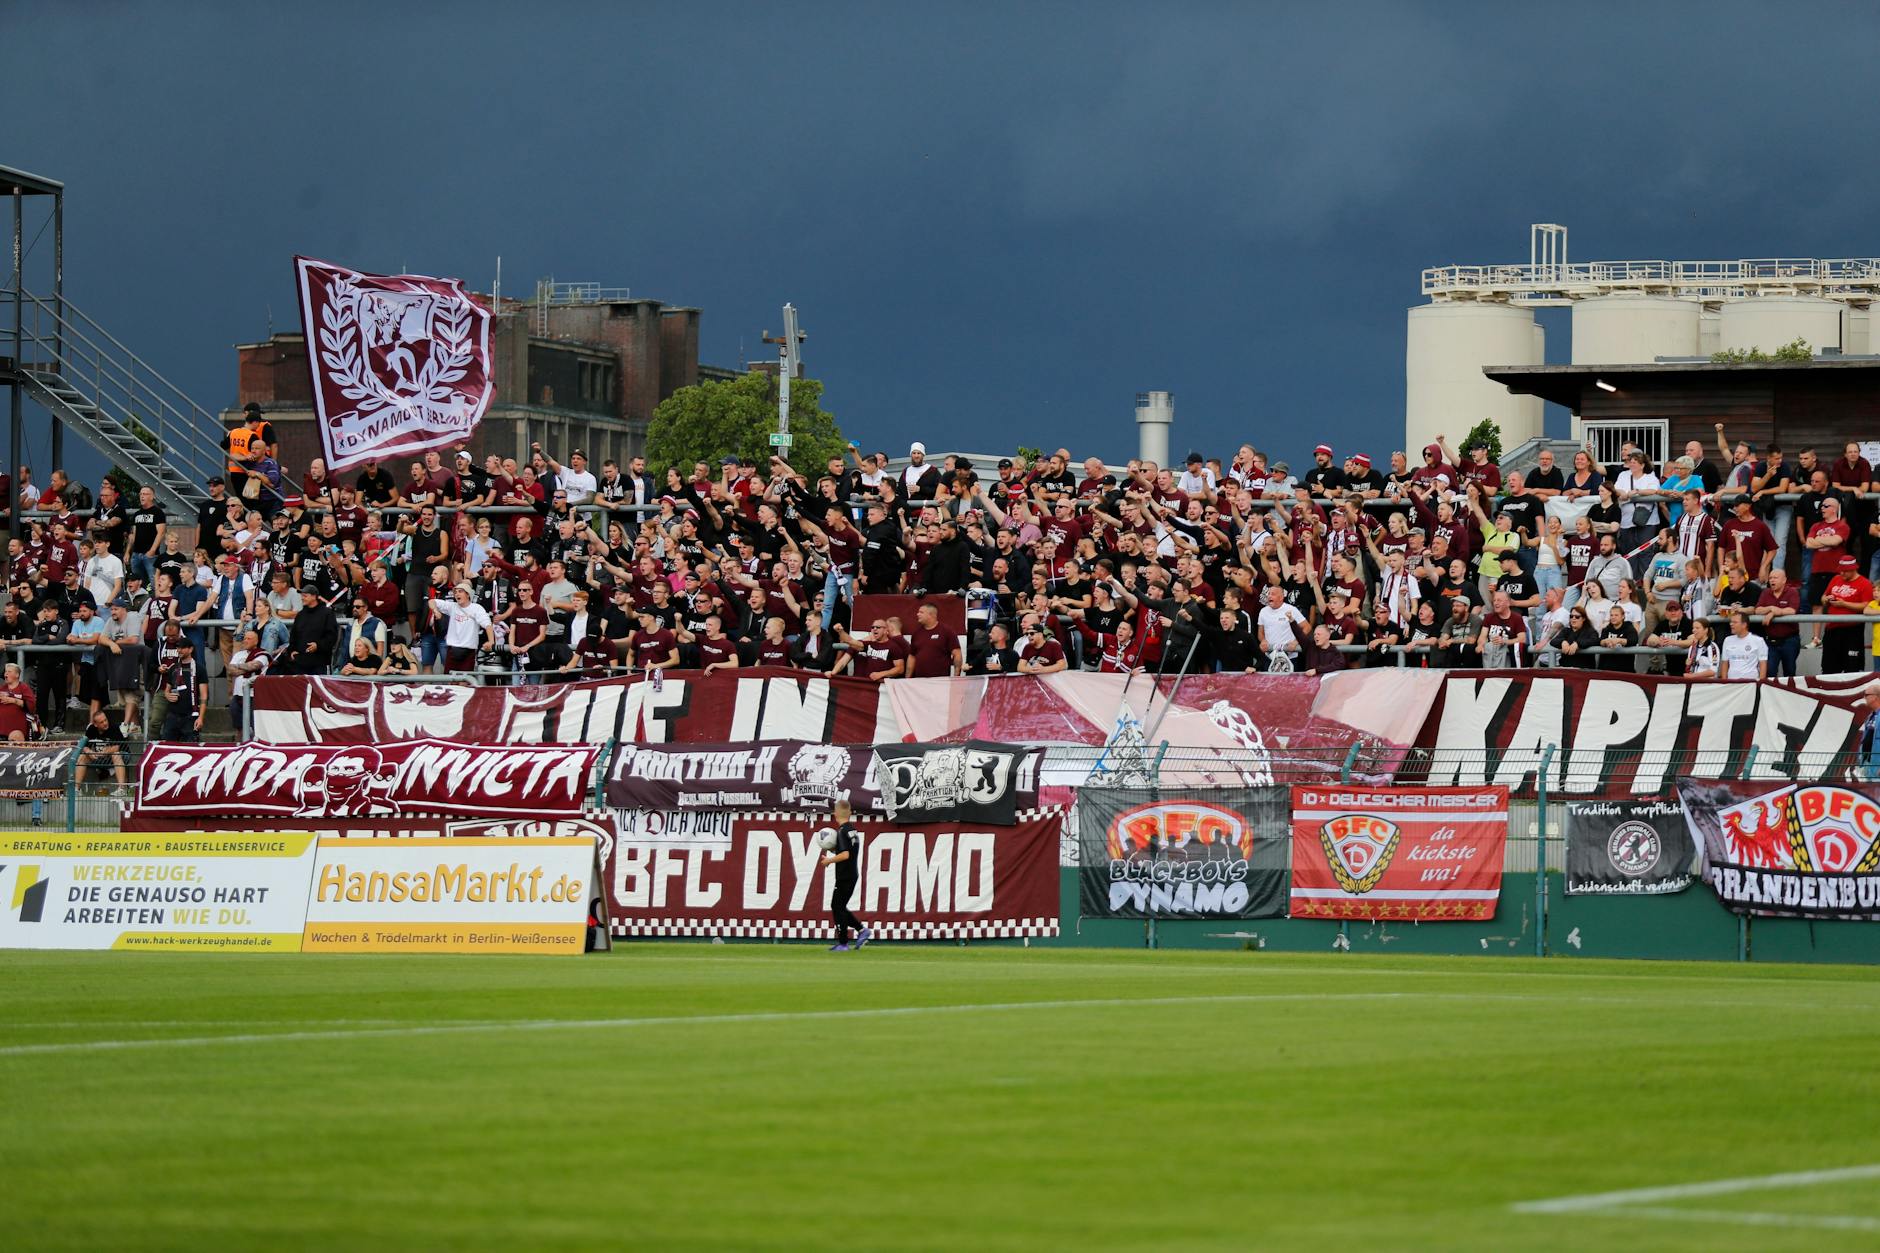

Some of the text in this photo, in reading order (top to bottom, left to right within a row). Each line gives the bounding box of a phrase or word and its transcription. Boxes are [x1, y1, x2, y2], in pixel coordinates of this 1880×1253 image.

[303, 559, 321, 571] BFC
[143, 744, 589, 801] BANDA INVICTA
[1329, 793, 1426, 807] DEUTSCHER
[1428, 794, 1498, 807] MEISTER
[1569, 802, 1621, 816] Tradition
[1800, 790, 1880, 838] BFC
[615, 808, 638, 834] ICK
[1330, 817, 1389, 841] BFC
[1430, 826, 1456, 841] da
[13, 841, 285, 851] BERATUNG REPARATUR BAUSTELLENSERVICE
[73, 865, 203, 883] WERKZEUGE,
[613, 838, 728, 907] BFC
[1110, 859, 1249, 882] BLACKBOYS
[317, 863, 583, 903] HansaMarkt.de
[1569, 879, 1643, 893] Leidenschaft
[1711, 866, 1880, 908] BRANDENBU
[68, 886, 269, 903] DIE GENAUSO HART
[1108, 881, 1250, 913] DYNAMO
[63, 908, 252, 925] ARBEITEN WIE DU.
[126, 936, 272, 947] www.hack-werkzeughandel.de
[311, 932, 576, 944] Wochen & Trödelmarkt in Berlin-Weißensee
